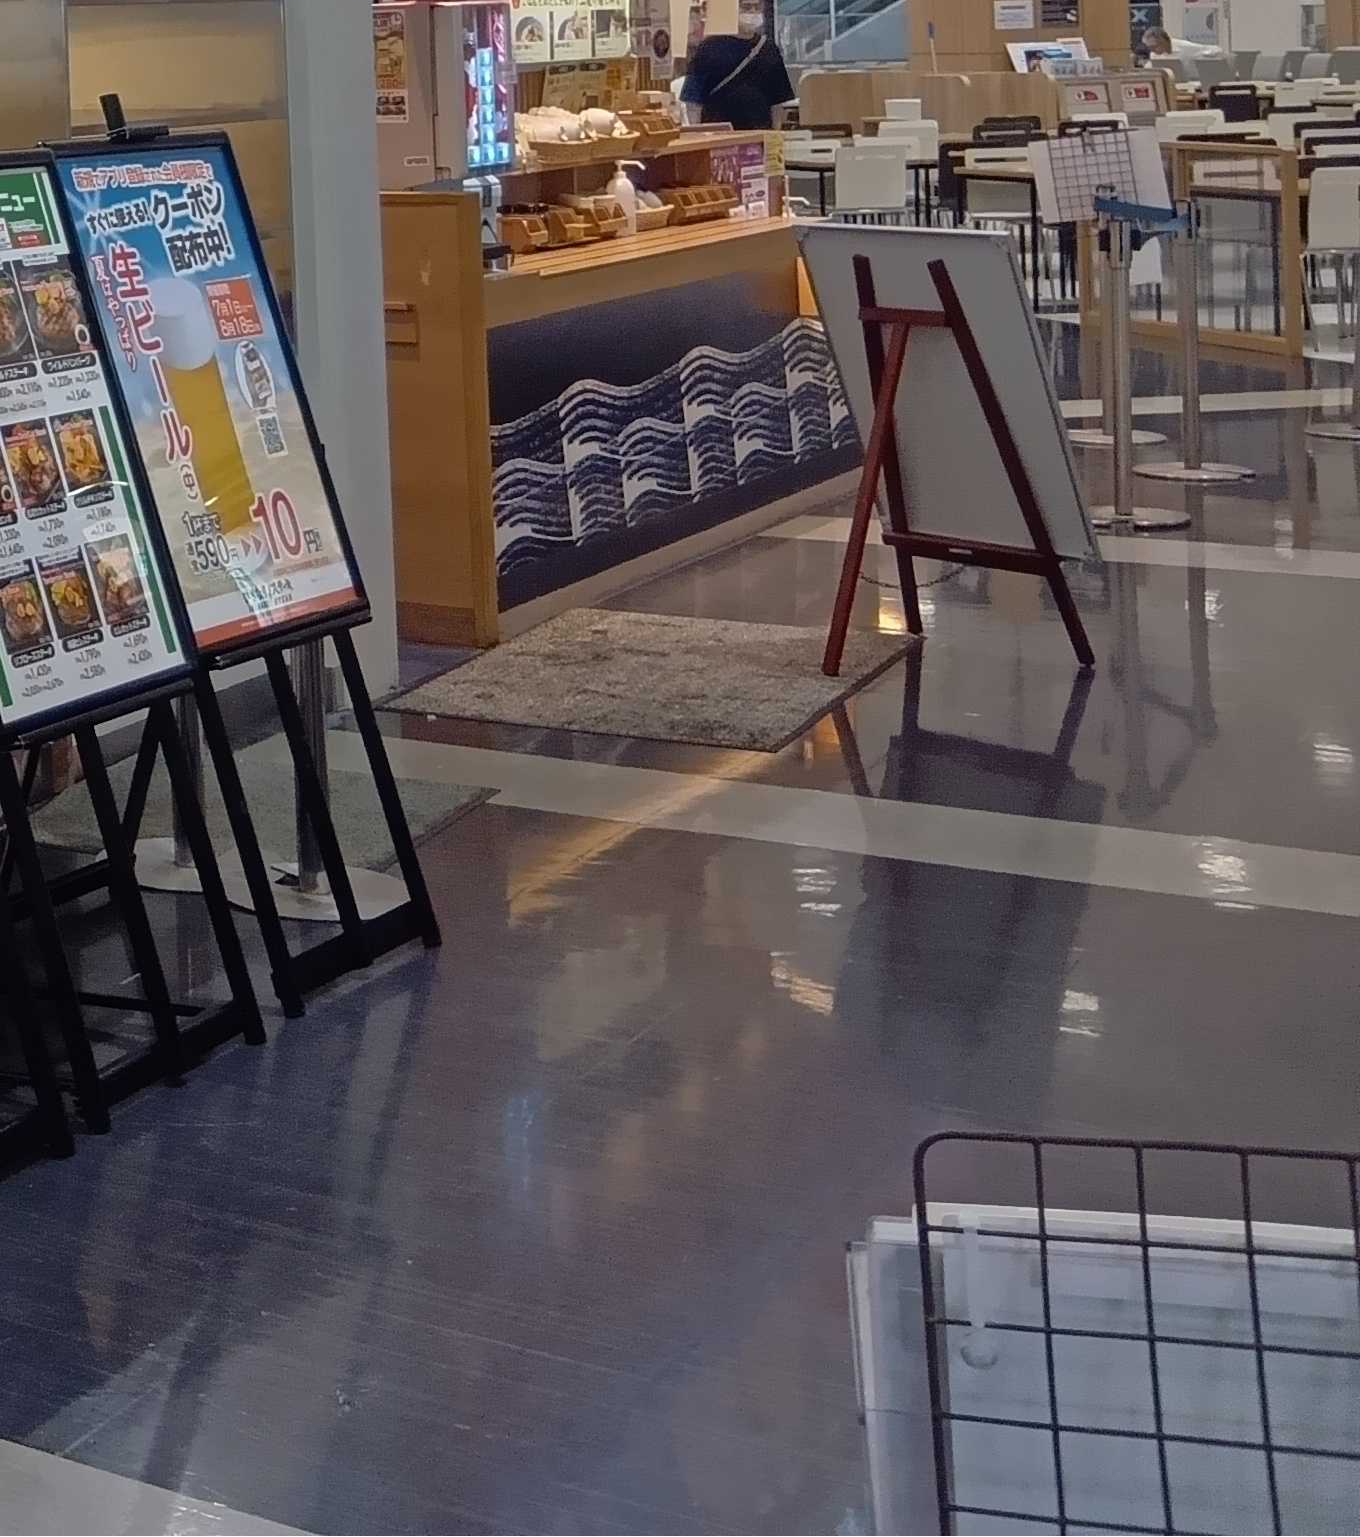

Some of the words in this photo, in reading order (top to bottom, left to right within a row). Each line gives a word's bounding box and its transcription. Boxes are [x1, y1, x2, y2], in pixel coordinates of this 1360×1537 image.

[153, 183, 222, 230] クーポン
[166, 222, 232, 273] 配布中!
[110, 244, 191, 461] 生ビール
